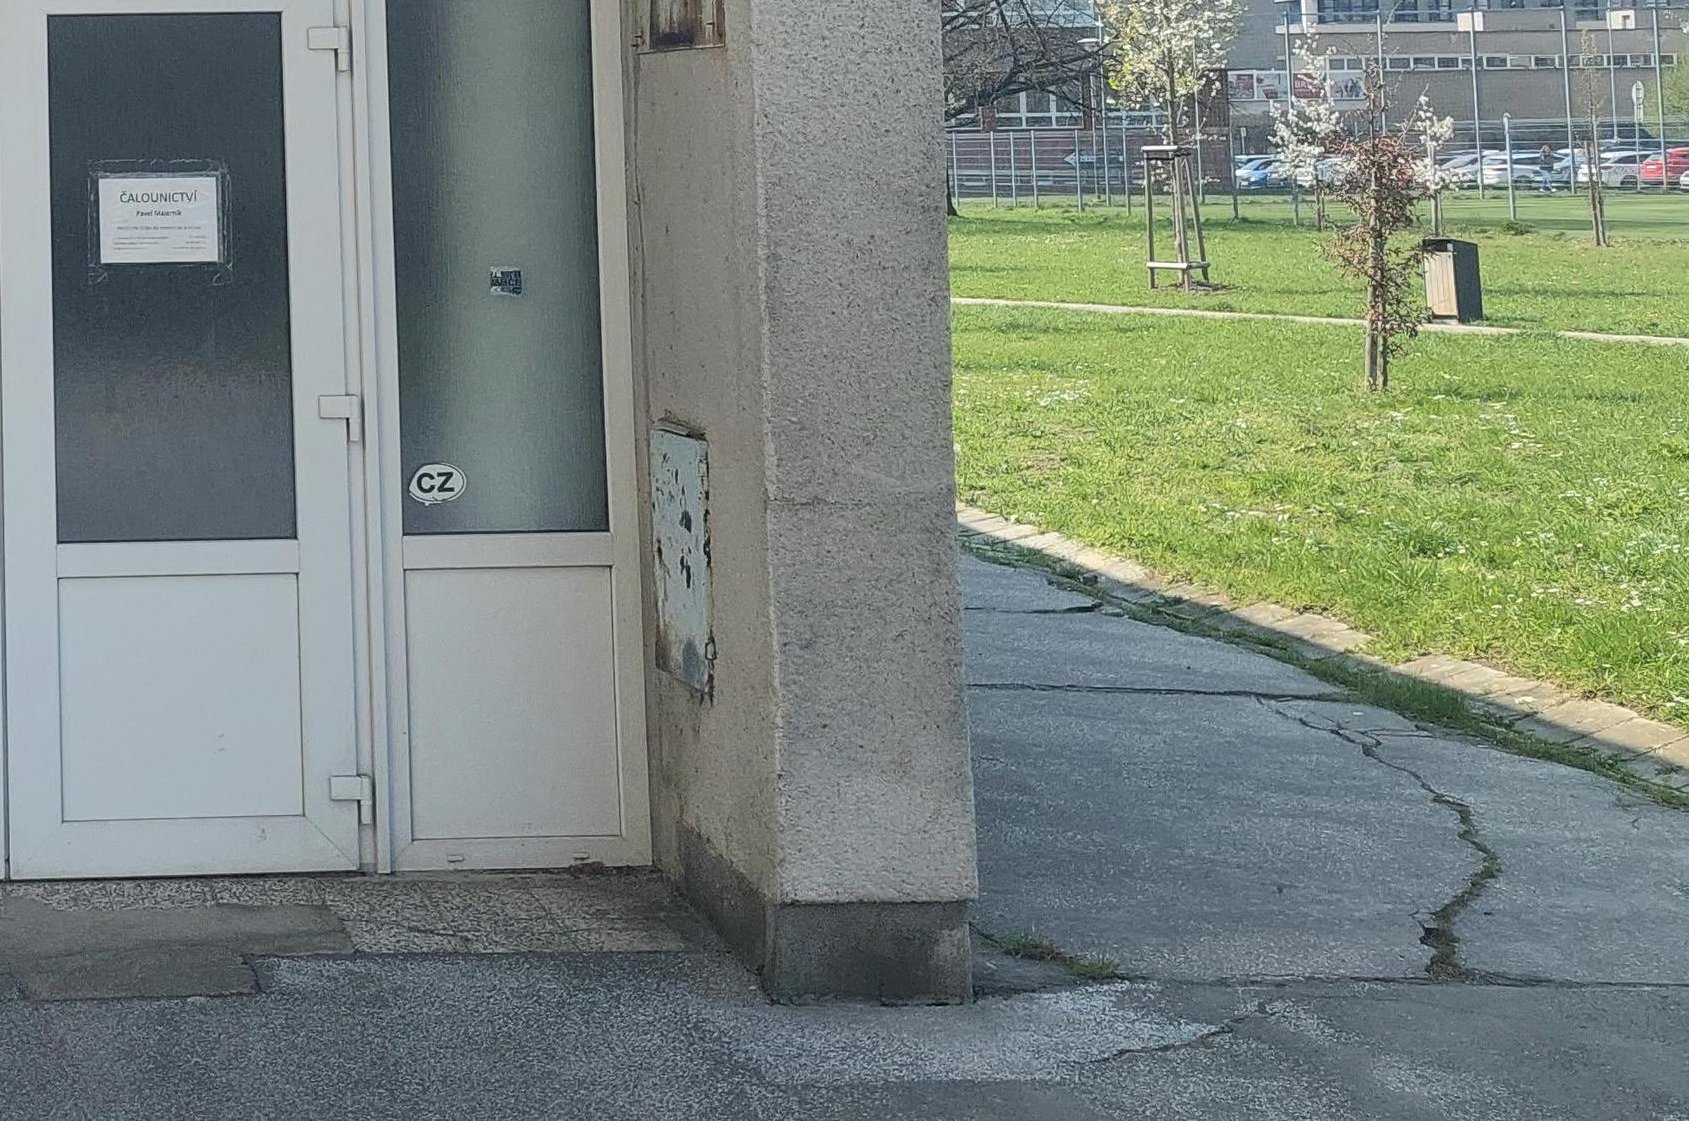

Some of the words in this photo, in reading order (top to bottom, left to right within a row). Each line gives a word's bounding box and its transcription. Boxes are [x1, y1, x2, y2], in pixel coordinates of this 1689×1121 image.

[119, 190, 198, 204] ČALOUNICTVÍ
[136, 209, 153, 217] Pavel
[416, 472, 456, 494] CZ
